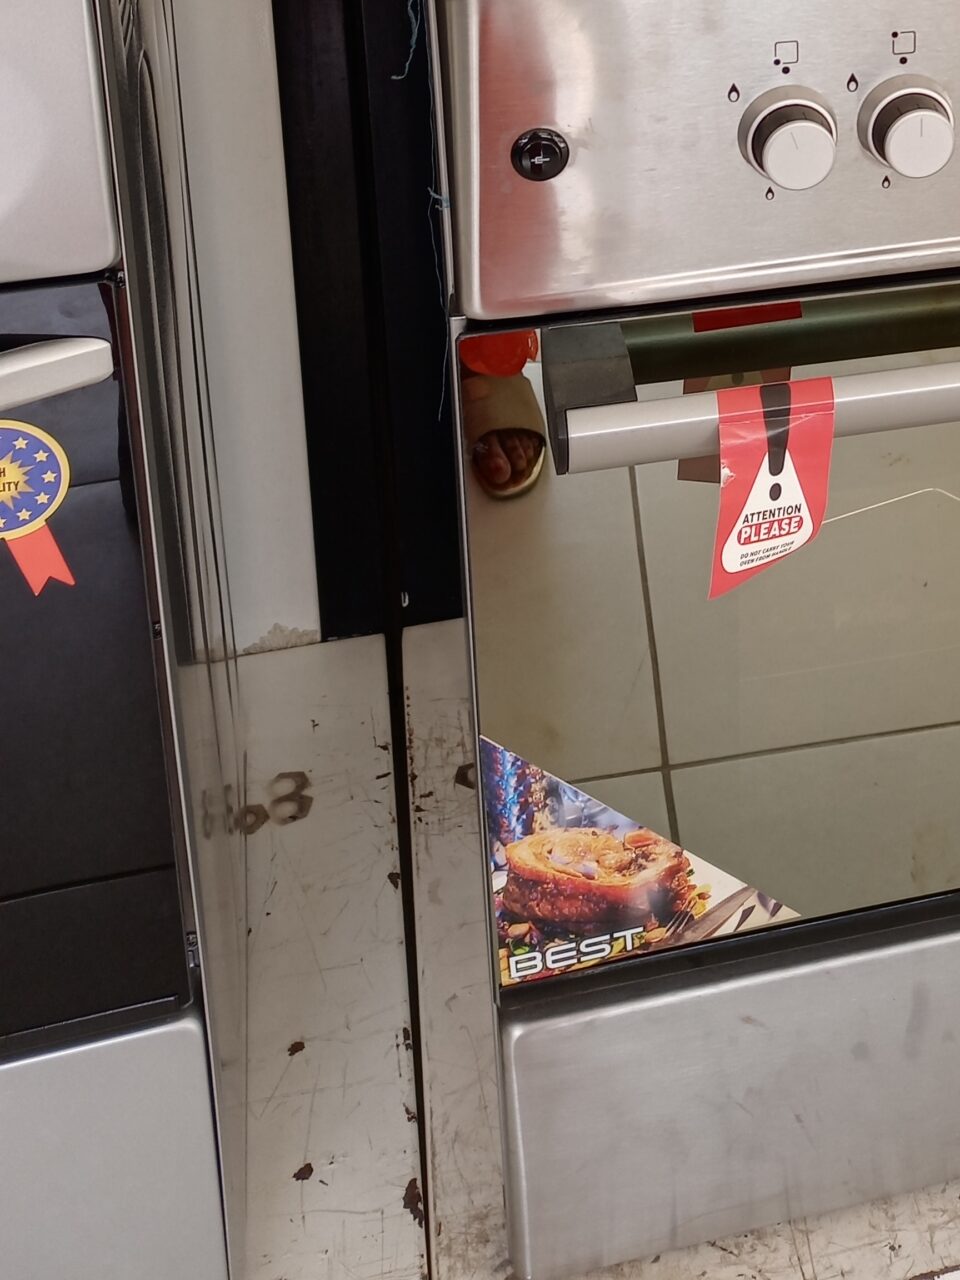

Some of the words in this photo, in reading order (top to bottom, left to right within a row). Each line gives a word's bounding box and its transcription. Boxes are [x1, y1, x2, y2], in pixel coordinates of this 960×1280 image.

[742, 503, 802, 525] ATTENTION
[740, 517, 801, 544] PLEASE
[508, 926, 644, 980] BEST
